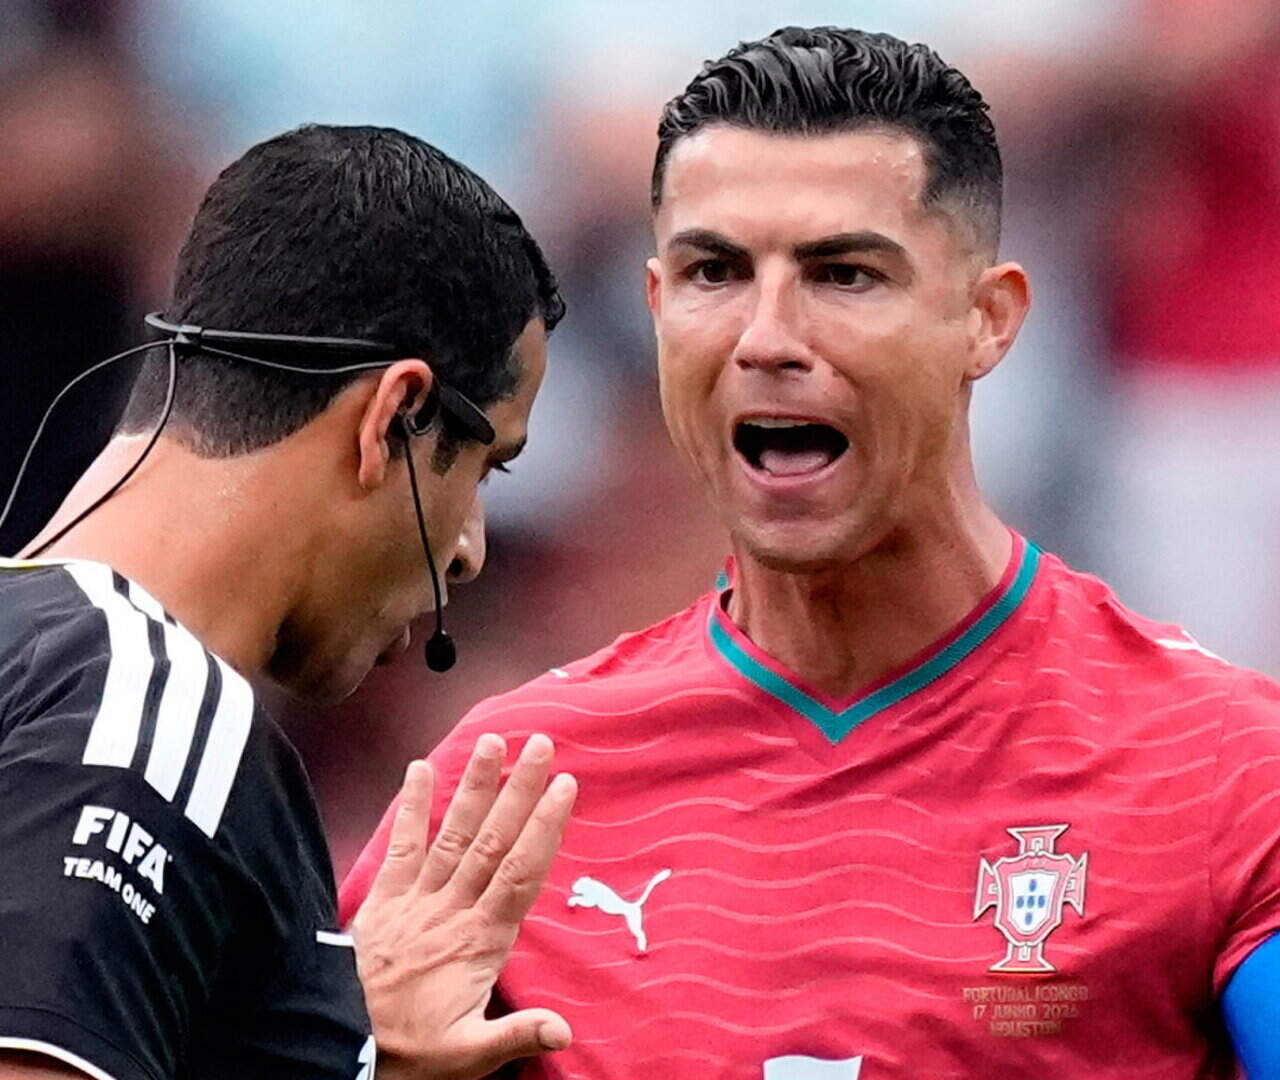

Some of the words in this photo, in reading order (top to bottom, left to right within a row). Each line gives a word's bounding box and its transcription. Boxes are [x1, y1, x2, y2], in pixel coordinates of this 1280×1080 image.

[72, 805, 168, 895] FIFA
[64, 857, 122, 892] TEAM
[122, 883, 156, 924] ONE
[973, 1004, 987, 1019] 17
